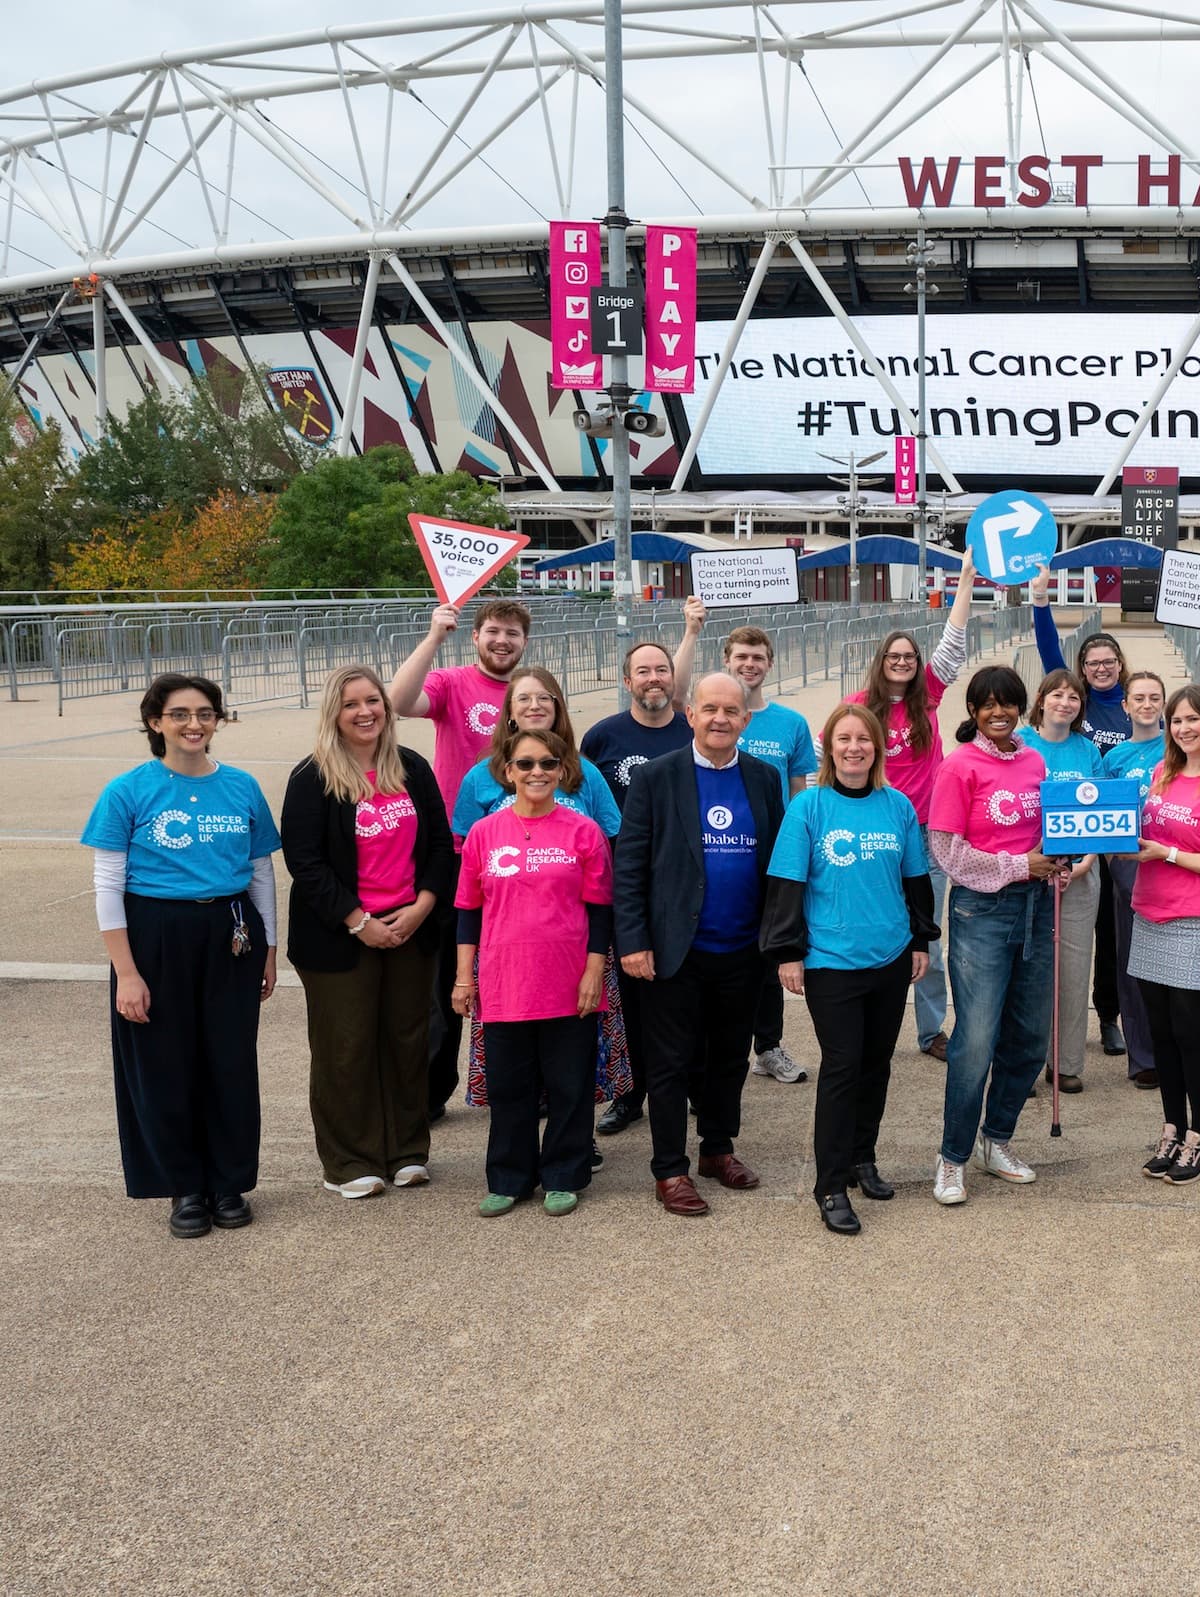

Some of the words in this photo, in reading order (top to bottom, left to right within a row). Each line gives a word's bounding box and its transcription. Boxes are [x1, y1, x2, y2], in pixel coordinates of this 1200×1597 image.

[898, 155, 1103, 208] WEST
[659, 233, 682, 356] PLAY
[598, 295, 634, 309] Bridge
[606, 311, 627, 347] 1
[772, 348, 960, 378] National
[969, 350, 1124, 377] Cancer
[268, 371, 291, 383] WEST
[291, 371, 312, 382] HAM
[280, 380, 305, 389] UNITED
[901, 439, 910, 489] LIVE
[432, 531, 499, 555] 35,000
[440, 550, 485, 566] voices
[697, 559, 716, 568] The
[718, 556, 763, 567] National
[1169, 558, 1185, 569] The
[698, 569, 735, 579] Cancer
[737, 567, 760, 578] Plan
[762, 567, 786, 576] must
[1167, 568, 1199, 581] Cancer
[699, 581, 713, 590] be
[724, 578, 760, 589] turning
[762, 577, 790, 588] point
[1166, 579, 1188, 590] must
[1188, 581, 1200, 591] be
[700, 592, 714, 601] for
[717, 591, 752, 600] cancer
[1165, 588, 1196, 601] turning
[1164, 597, 1176, 606] for
[1093, 734, 1123, 745] RESEAR
[1096, 730, 1126, 740] CANCER
[748, 739, 779, 749] CANCER
[748, 746, 787, 758] RESEARCH
[378, 799, 414, 815] CANCE
[1024, 809, 1036, 817] UK
[1162, 801, 1192, 816] CANCER
[196, 814, 242, 825] CANCER
[712, 809, 727, 826] B
[1155, 815, 1166, 827] UK
[1157, 807, 1198, 828] RESEARCH
[197, 824, 249, 834] RESEARC
[384, 818, 400, 830] UK
[1048, 813, 1132, 835] 35,054
[199, 833, 214, 842] UK
[859, 832, 897, 843] CANCER
[526, 847, 566, 856] CANCER
[860, 841, 901, 852] RESEARC
[526, 855, 577, 864] RESEARCH
[860, 851, 876, 861] UK
[525, 864, 540, 873] UK
